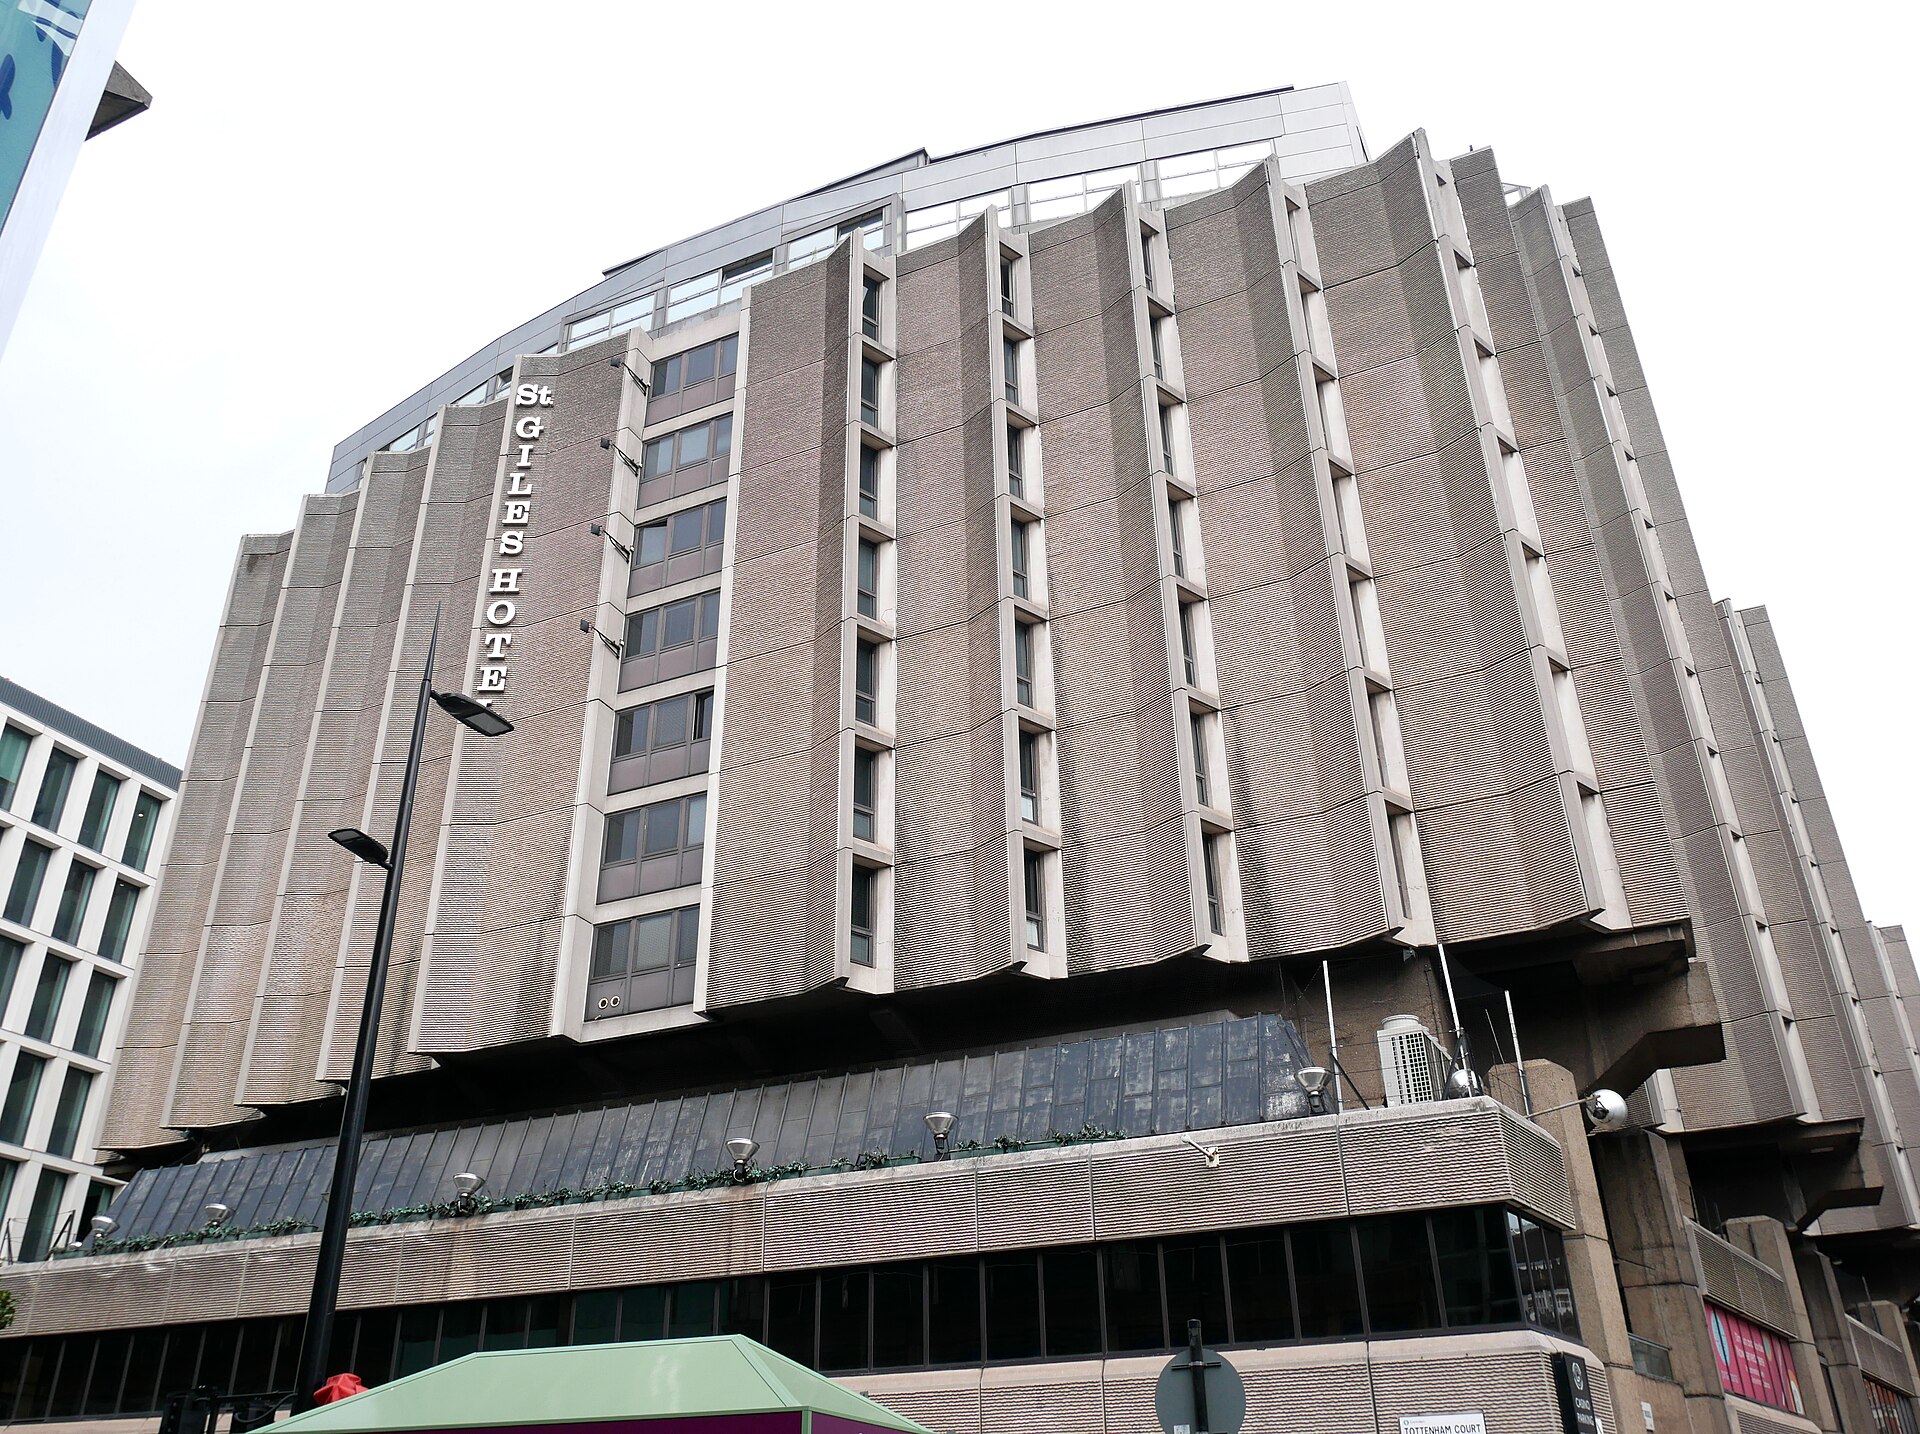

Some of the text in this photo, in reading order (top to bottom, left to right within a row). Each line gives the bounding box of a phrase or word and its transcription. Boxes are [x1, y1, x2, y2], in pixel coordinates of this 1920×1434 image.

[499, 416, 544, 554] GILES
[1404, 1424, 1481, 1434] TOTTENHAM COURT
